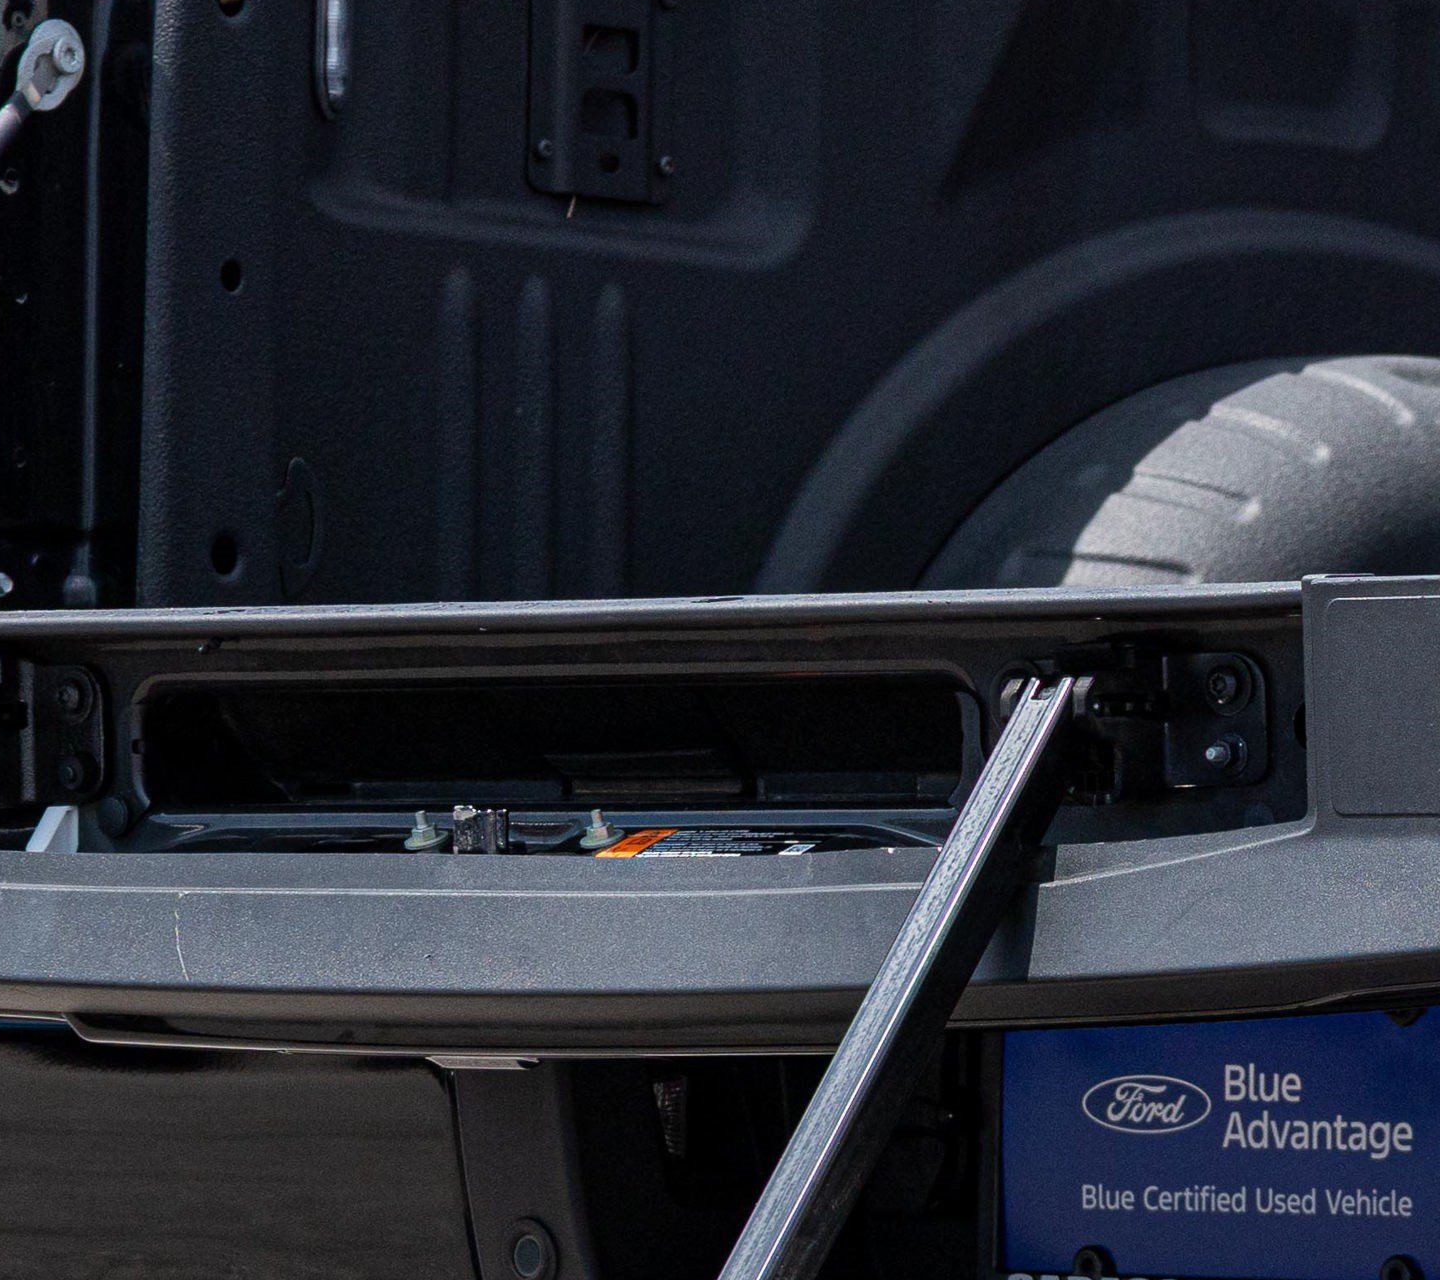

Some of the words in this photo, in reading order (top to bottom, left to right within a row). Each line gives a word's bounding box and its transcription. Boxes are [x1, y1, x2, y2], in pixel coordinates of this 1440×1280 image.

[1225, 1063, 1301, 1101] Blue
[1106, 1081, 1187, 1125] Ford
[1223, 1111, 1412, 1159] Advantage
[1083, 1184, 1134, 1209] Blue
[1144, 1185, 1245, 1212] Certified
[1257, 1188, 1315, 1213] Used
[1326, 1190, 1412, 1216] Vehicle
